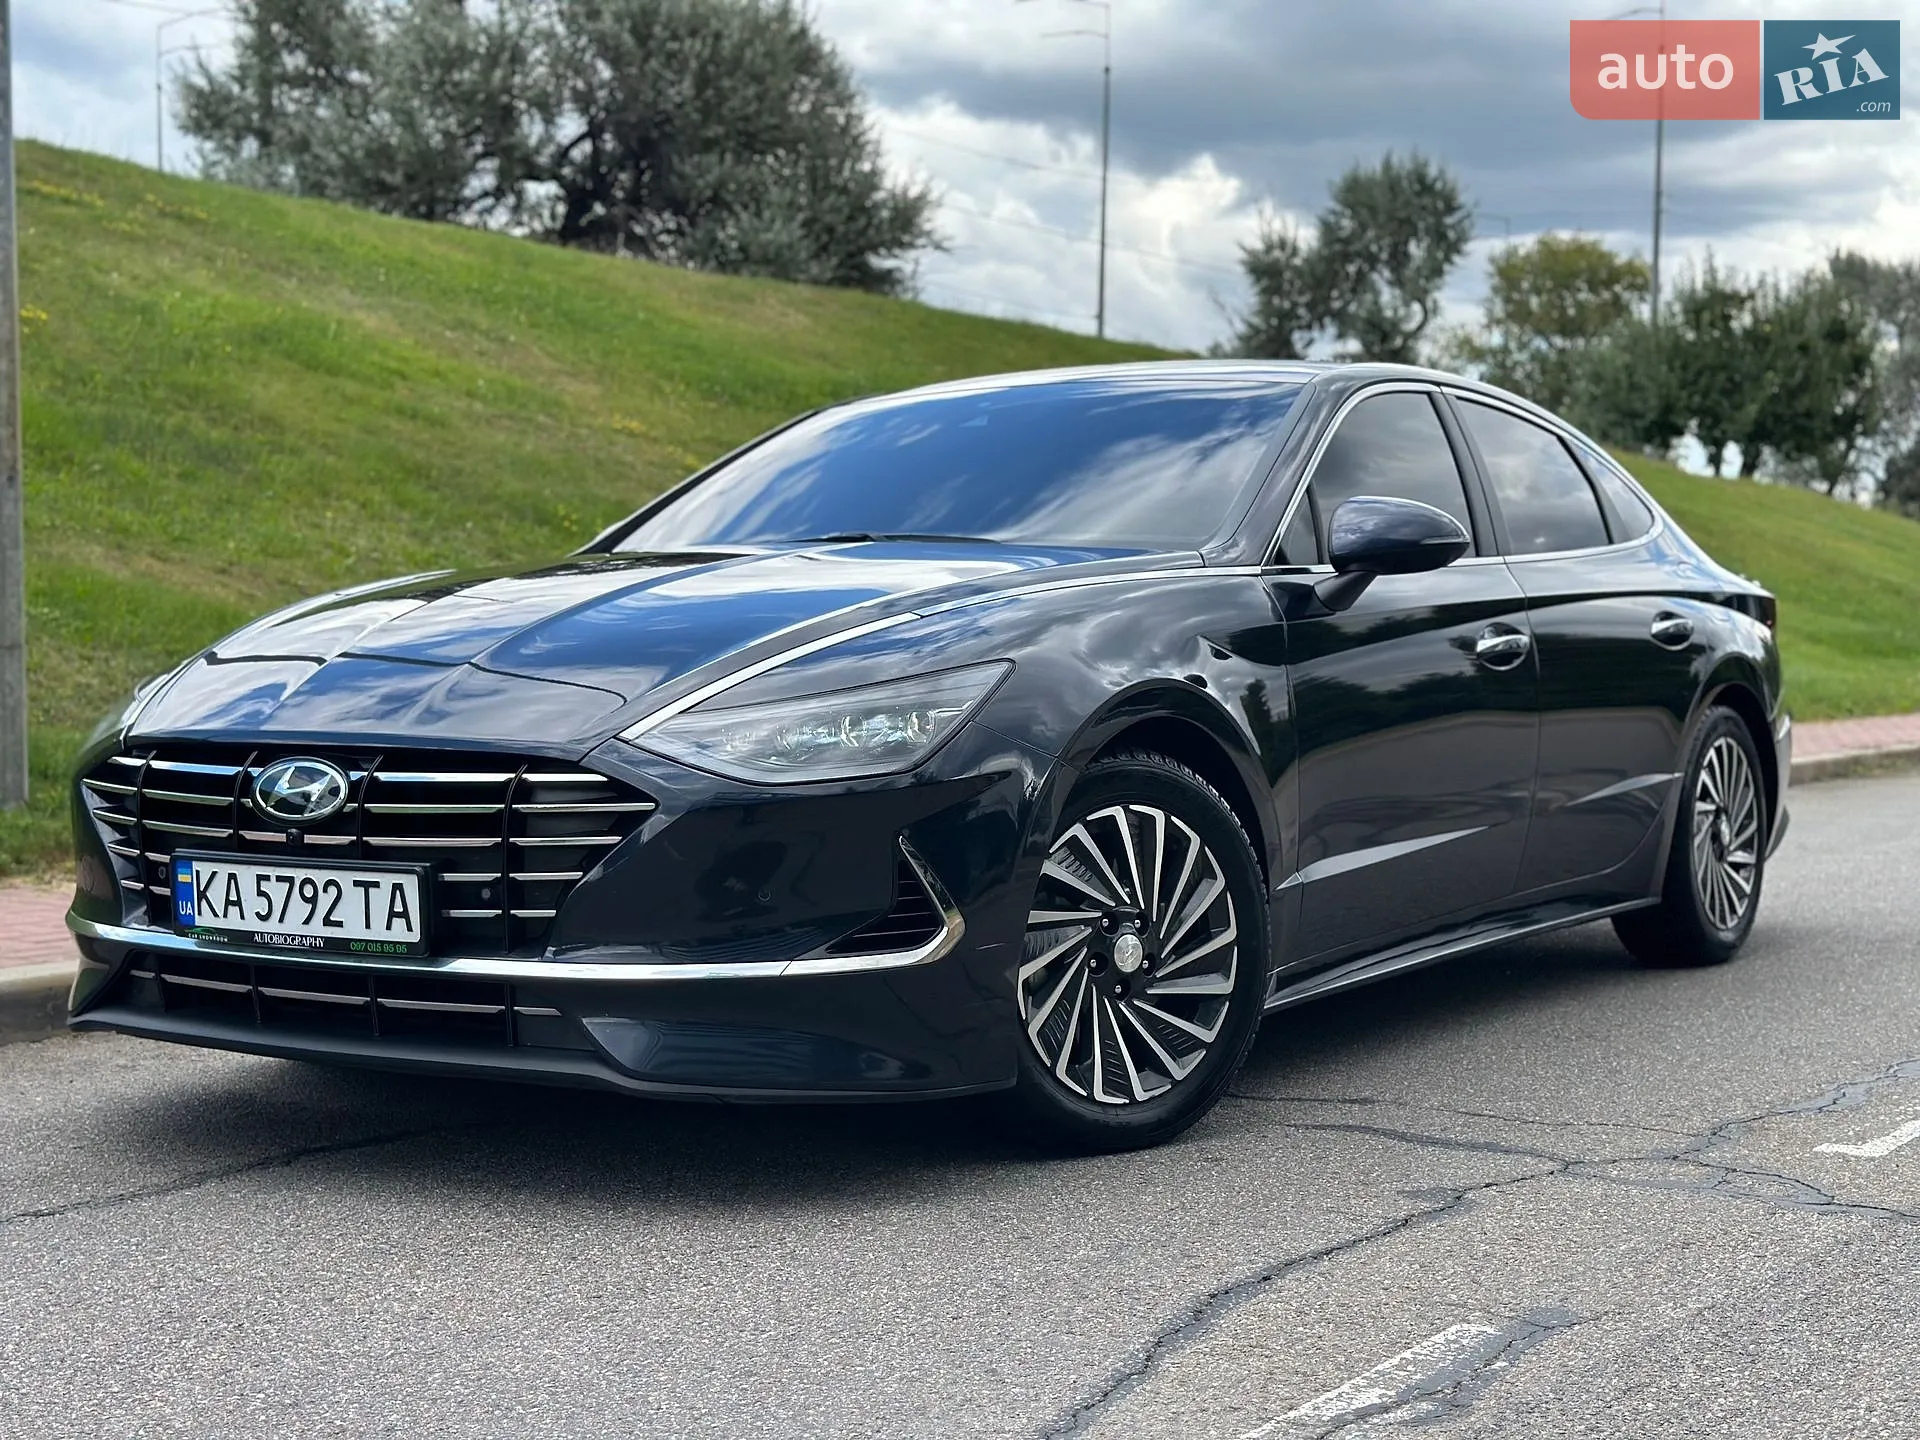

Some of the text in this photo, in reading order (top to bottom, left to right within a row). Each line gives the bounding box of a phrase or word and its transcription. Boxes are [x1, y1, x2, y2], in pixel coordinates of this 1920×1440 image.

[179, 900, 194, 916] UA
[195, 869, 414, 932] KA 5792 TA
[253, 932, 325, 948] AUTOBIOGRAPHY
[367, 942, 382, 952] 015
